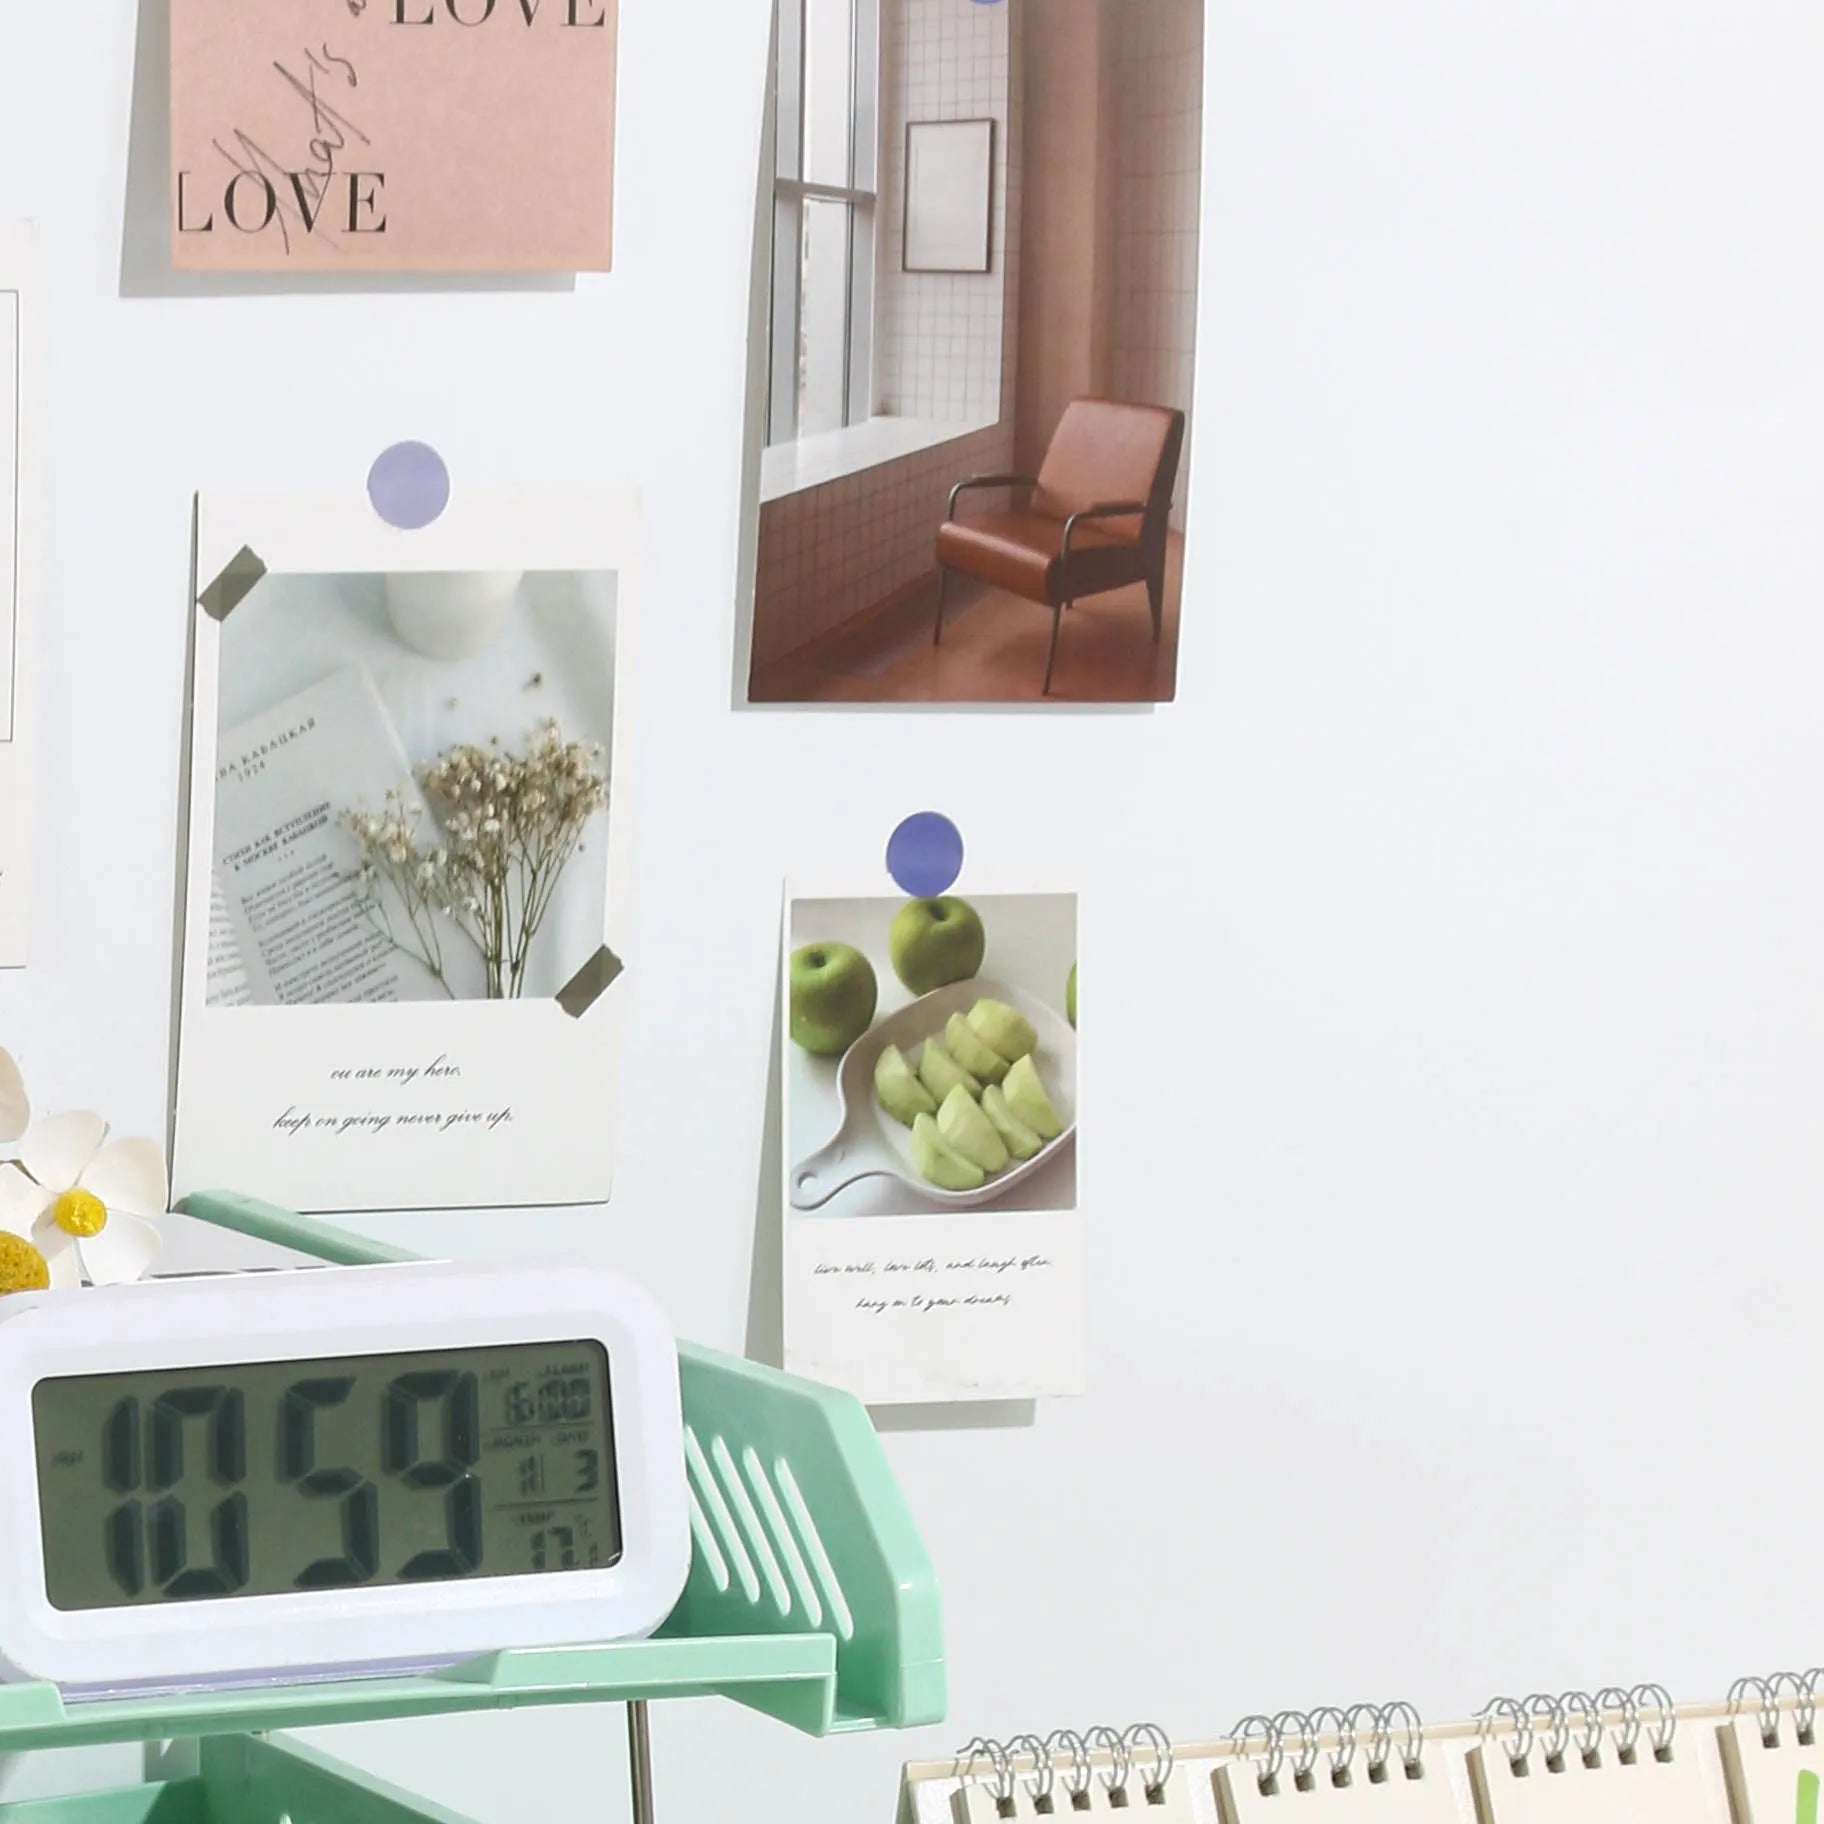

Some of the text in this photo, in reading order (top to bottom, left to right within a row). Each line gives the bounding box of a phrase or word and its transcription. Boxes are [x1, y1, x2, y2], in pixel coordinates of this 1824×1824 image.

[177, 170, 387, 234] LOVE
[354, 1067, 382, 1079] are
[386, 1067, 419, 1087] my
[272, 1104, 312, 1137] keep
[333, 1110, 392, 1136] going
[395, 1113, 442, 1127] never
[437, 1109, 483, 1133] give
